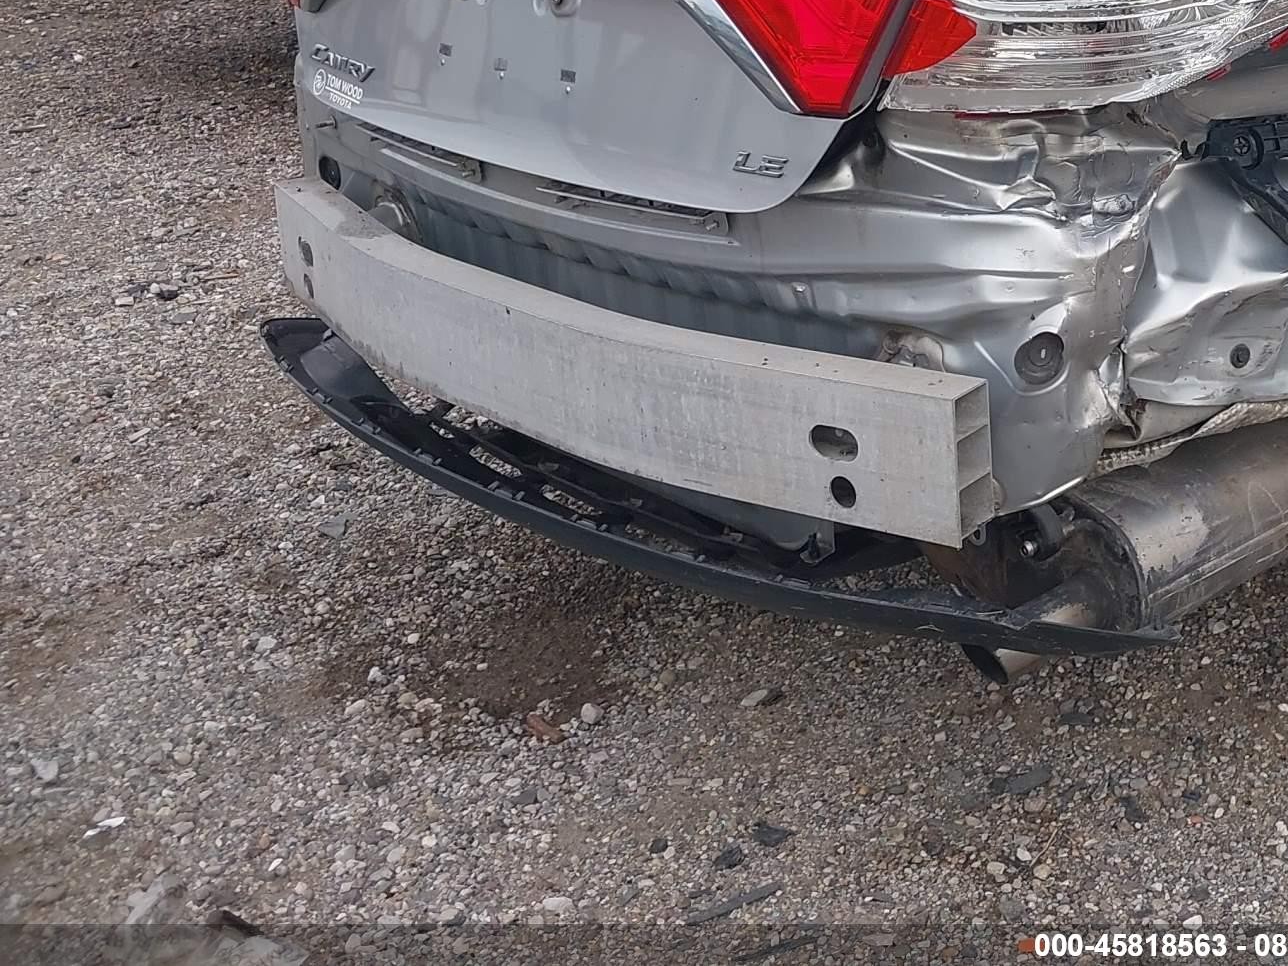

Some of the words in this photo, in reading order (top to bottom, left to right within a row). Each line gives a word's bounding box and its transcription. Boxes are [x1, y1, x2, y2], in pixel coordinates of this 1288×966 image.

[326, 73, 342, 90] TOM
[341, 80, 363, 100] WOOD
[329, 92, 352, 109] TOYOTA
[733, 151, 789, 178] LE
